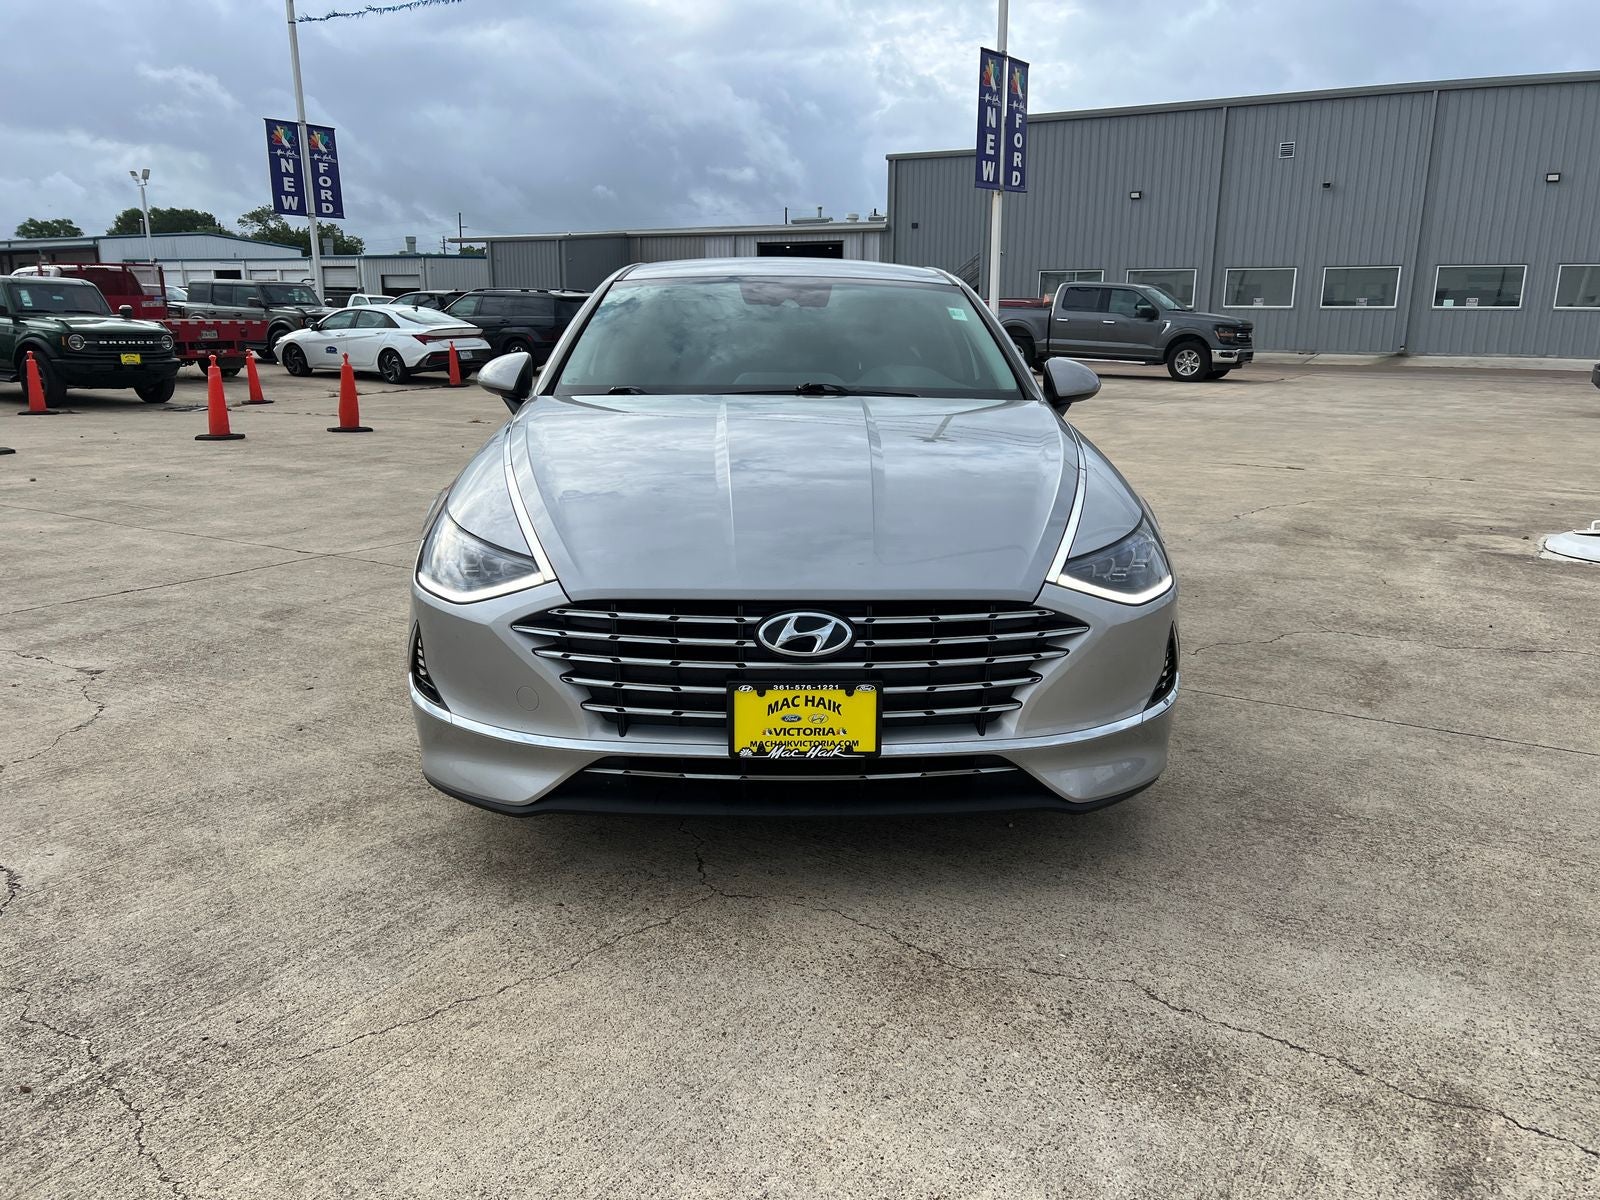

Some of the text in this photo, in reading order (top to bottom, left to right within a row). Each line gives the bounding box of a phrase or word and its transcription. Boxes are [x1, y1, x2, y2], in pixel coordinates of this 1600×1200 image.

[982, 106, 997, 182] NEW
[1011, 113, 1023, 186] FORD
[280, 158, 298, 211] NEW
[318, 162, 334, 214] FORD
[767, 695, 842, 716] MAC HAIK
[773, 727, 836, 737] VICTORIA
